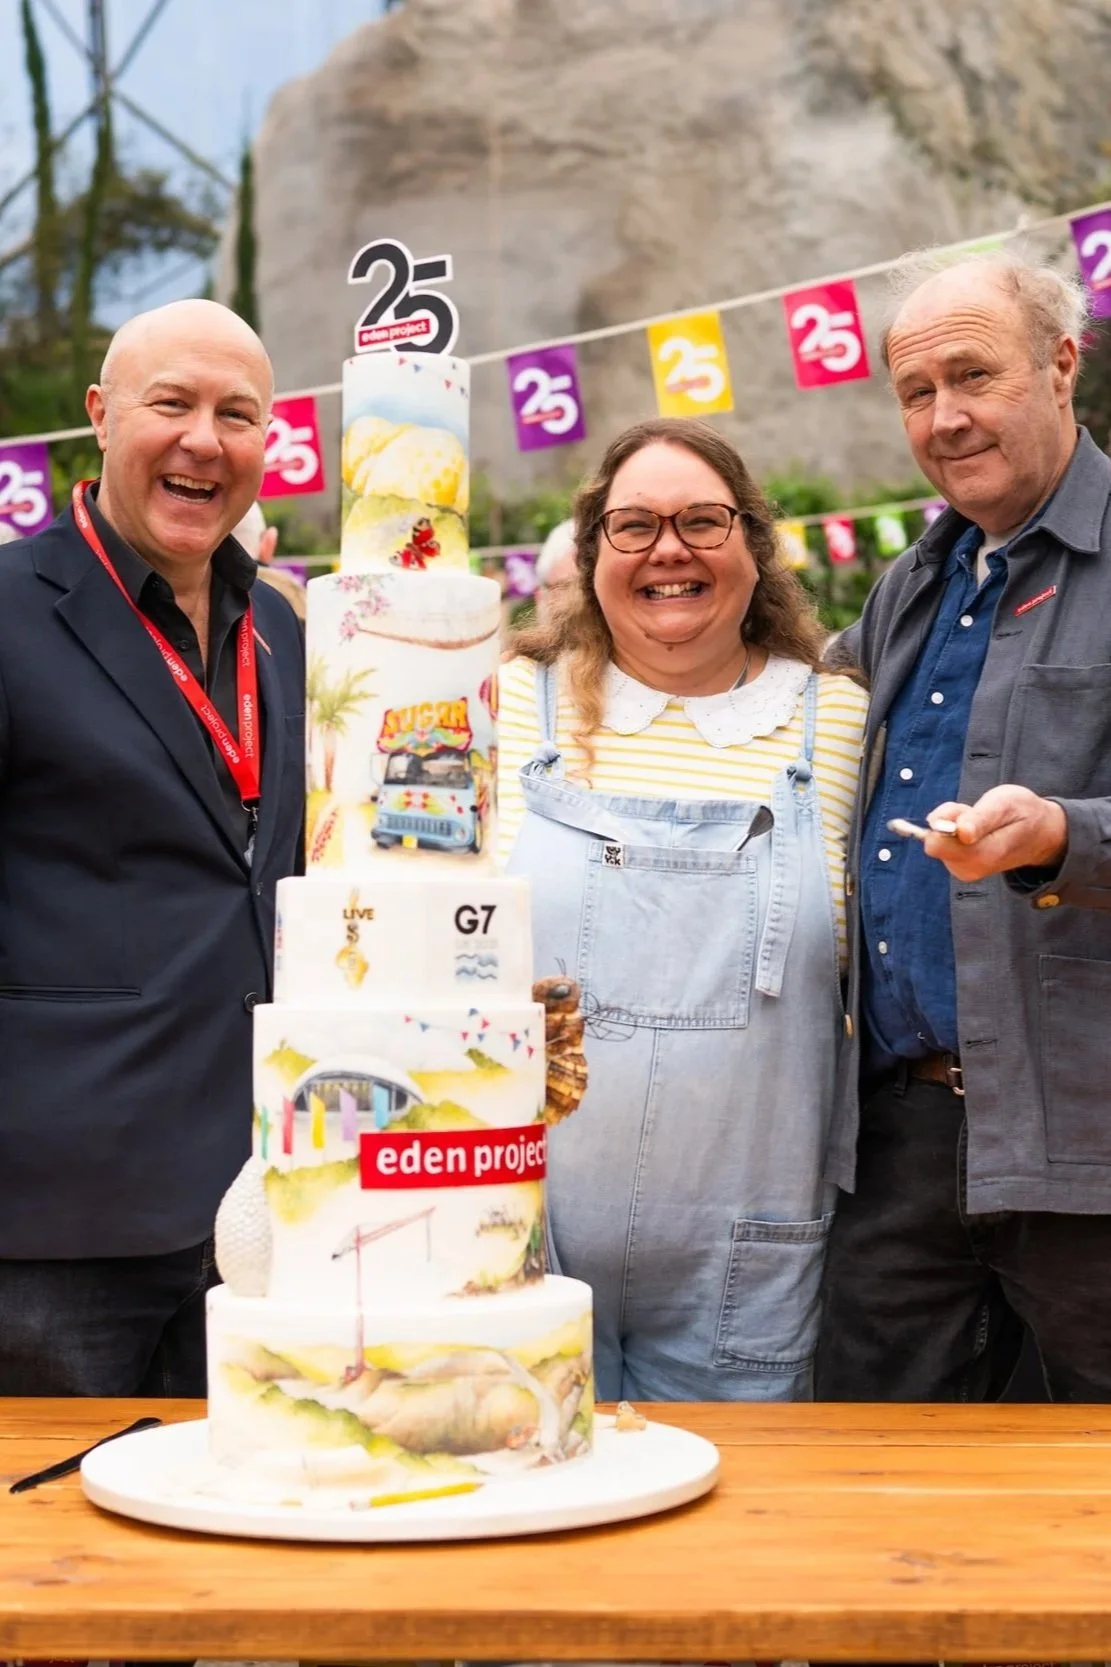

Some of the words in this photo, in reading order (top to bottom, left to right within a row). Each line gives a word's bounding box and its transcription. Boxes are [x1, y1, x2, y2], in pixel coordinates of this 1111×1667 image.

[1081, 229, 1111, 284] 2
[350, 241, 455, 354] 25
[361, 328, 389, 343] eden
[388, 319, 428, 341] project
[790, 303, 863, 373] 25
[658, 336, 725, 402] 25
[512, 366, 580, 435] 25
[263, 416, 320, 486] 25
[0, 460, 48, 528] 25
[240, 631, 251, 668] project
[166, 657, 188, 682] eden
[200, 704, 227, 740] project
[243, 694, 253, 721] eden
[383, 700, 467, 735] SUGAR
[222, 737, 240, 764] eden
[243, 721, 255, 759] project
[342, 907, 375, 921] LIVE
[454, 904, 497, 935] G7
[376, 1139, 467, 1175] eden
